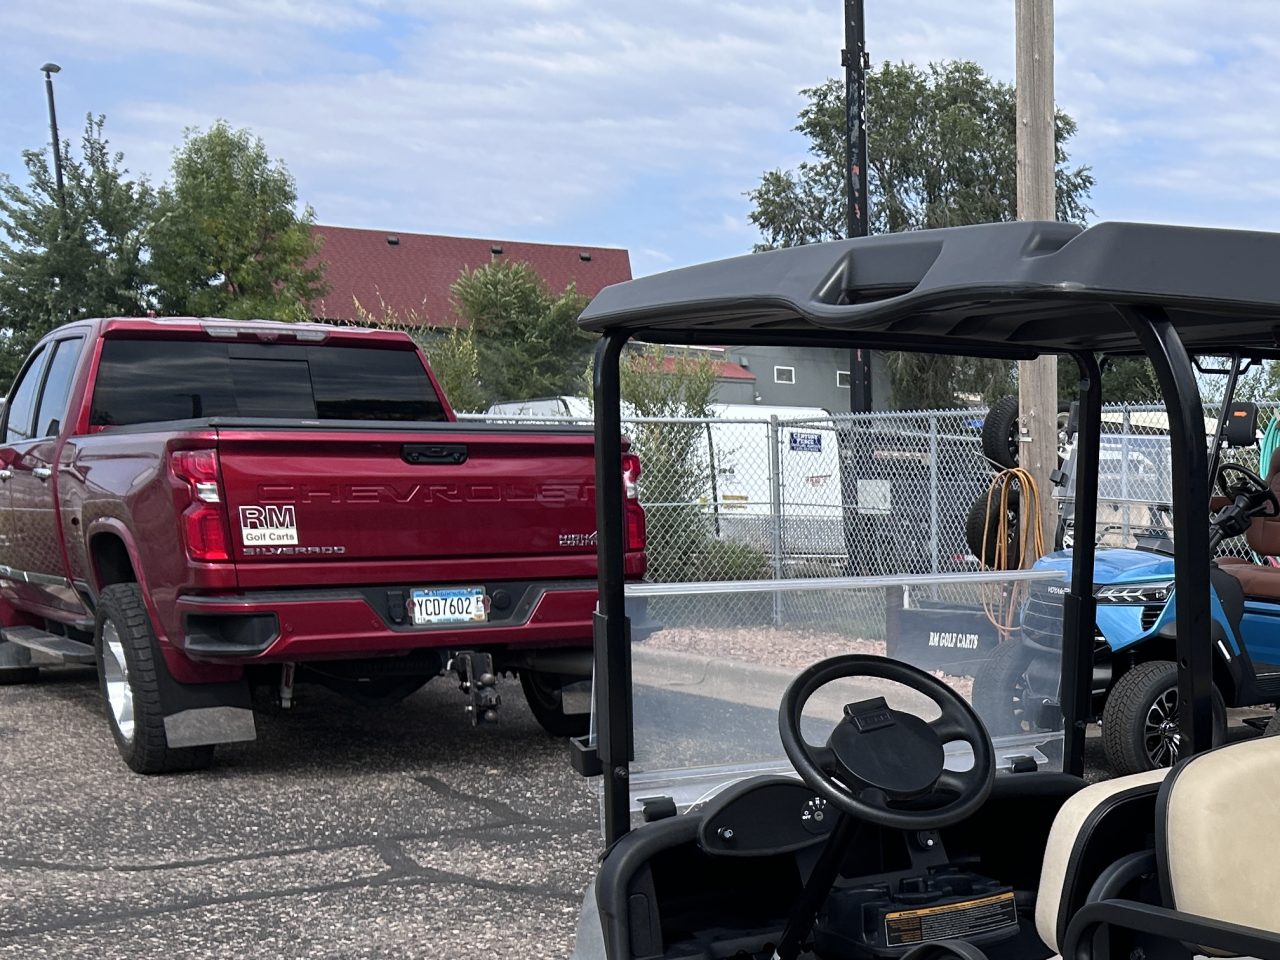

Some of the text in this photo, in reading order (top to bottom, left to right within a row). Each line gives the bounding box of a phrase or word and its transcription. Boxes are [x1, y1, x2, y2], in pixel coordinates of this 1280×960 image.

[239, 505, 297, 529] RM
[246, 532, 295, 541] Golf Carts
[243, 546, 346, 556] SILVERADO
[417, 597, 472, 616] YCD7602
[928, 631, 979, 649] RM GOLF CARTS
